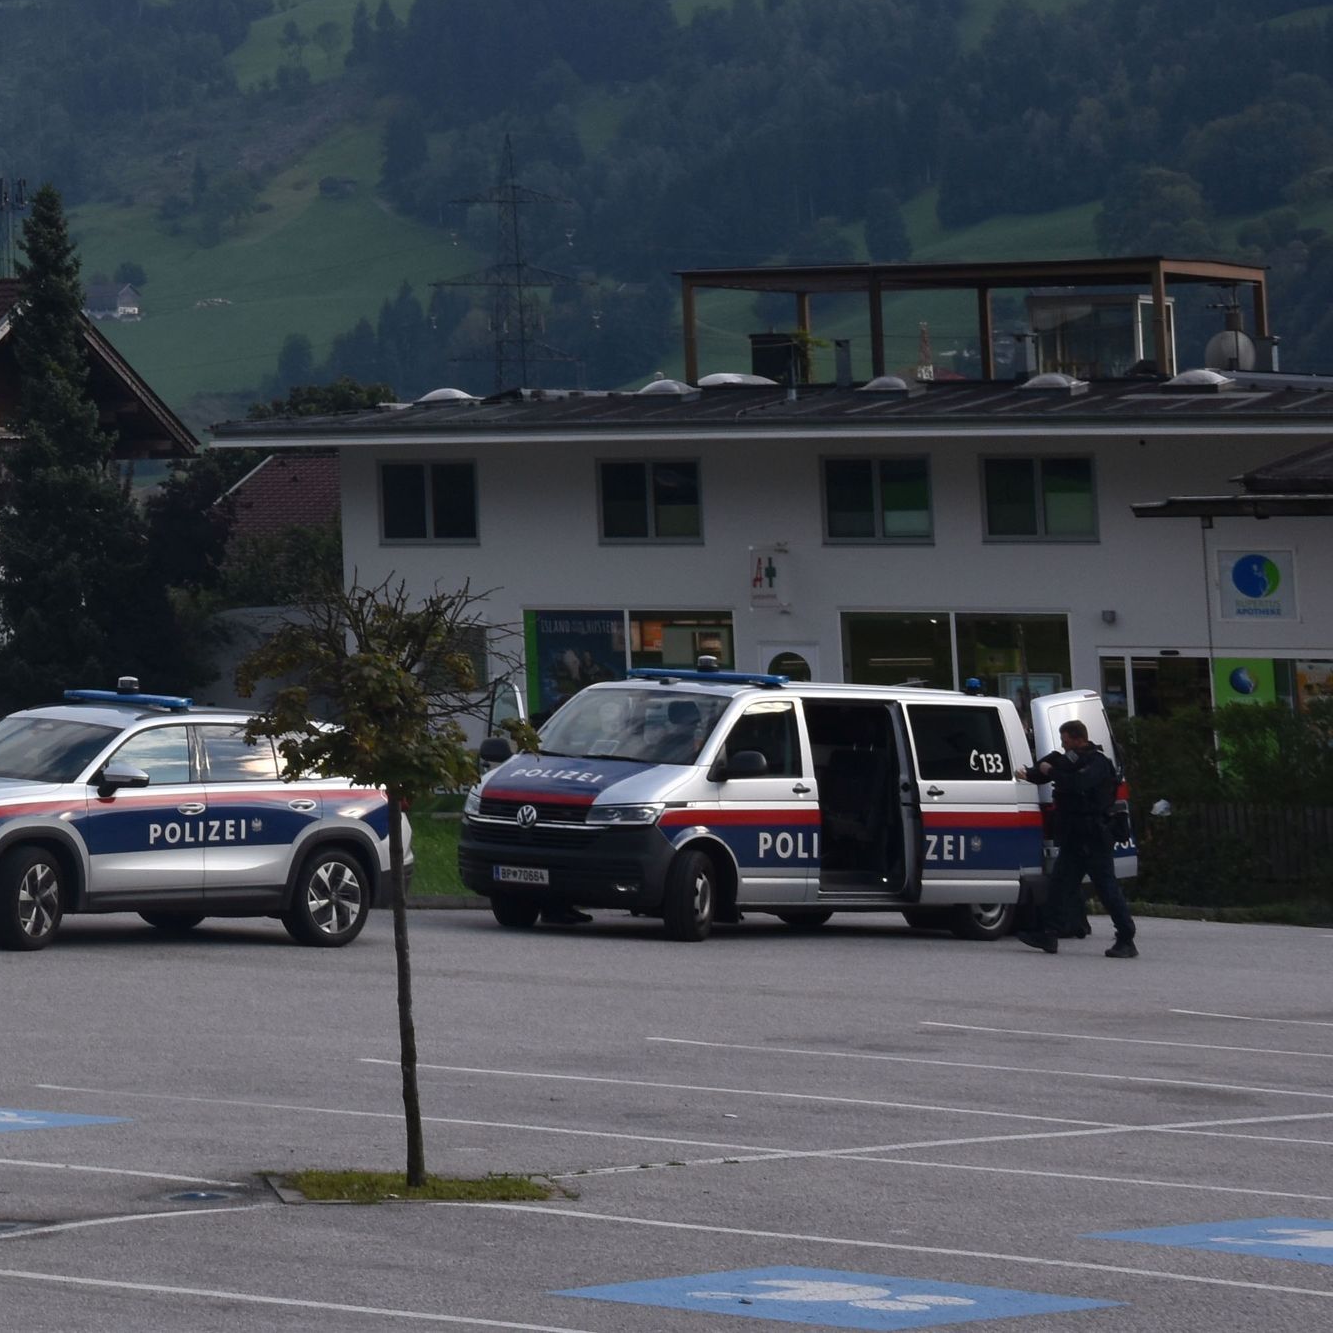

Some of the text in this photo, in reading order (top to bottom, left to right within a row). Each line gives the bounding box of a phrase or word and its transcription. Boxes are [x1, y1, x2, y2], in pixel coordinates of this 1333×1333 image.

[1236, 608, 1282, 616] APOTHEKE
[510, 768, 604, 783] POLIZEI
[979, 753, 1005, 775] 133
[149, 819, 246, 845] POLIZEI
[758, 831, 819, 859] POLI
[925, 834, 966, 861] ZEI
